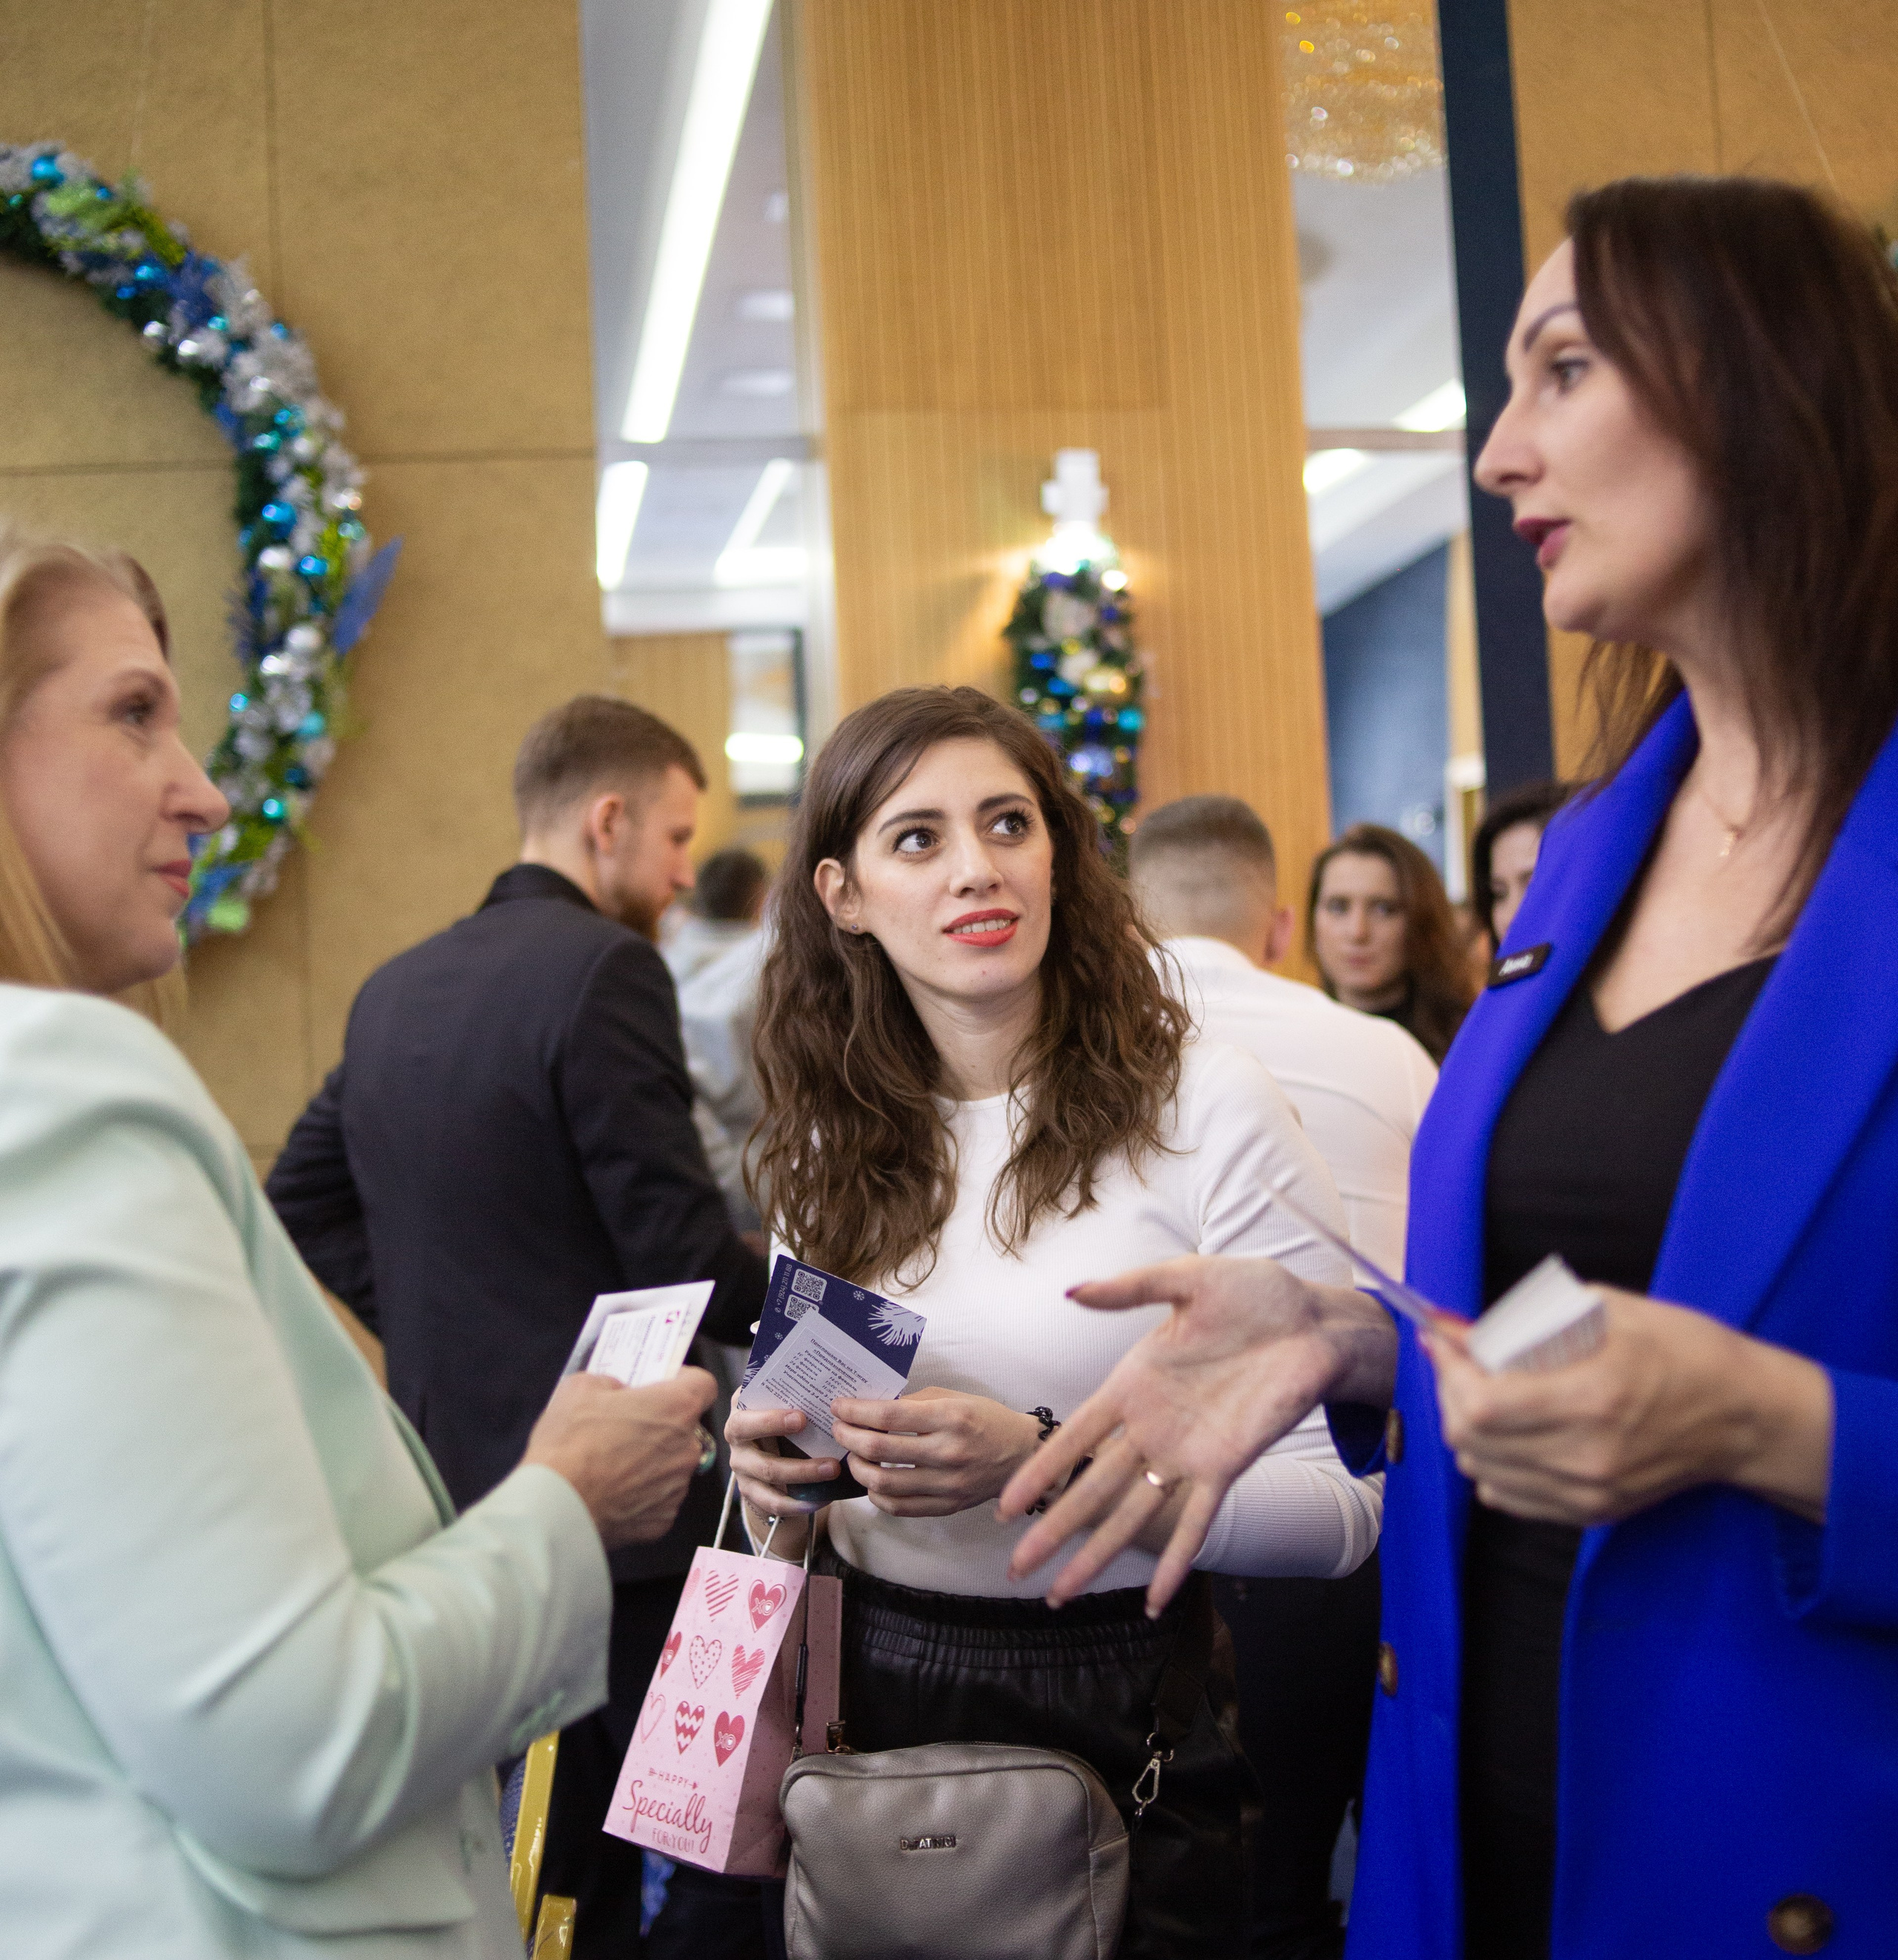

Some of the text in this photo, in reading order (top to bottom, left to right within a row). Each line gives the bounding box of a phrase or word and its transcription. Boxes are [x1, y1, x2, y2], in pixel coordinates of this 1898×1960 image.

[810, 1339, 838, 1360] Приглашаю
[783, 1370, 810, 1393] Участников
[784, 1364, 796, 1374] Игра
[810, 1383, 824, 1394] около
[804, 1350, 831, 1371] Расписание
[837, 1375, 858, 1391] февраль
[773, 1391, 782, 1399] 222
[658, 1771, 689, 1787] HAPPY
[622, 1780, 712, 1854] Specially
[652, 1828, 670, 1847] FOR
